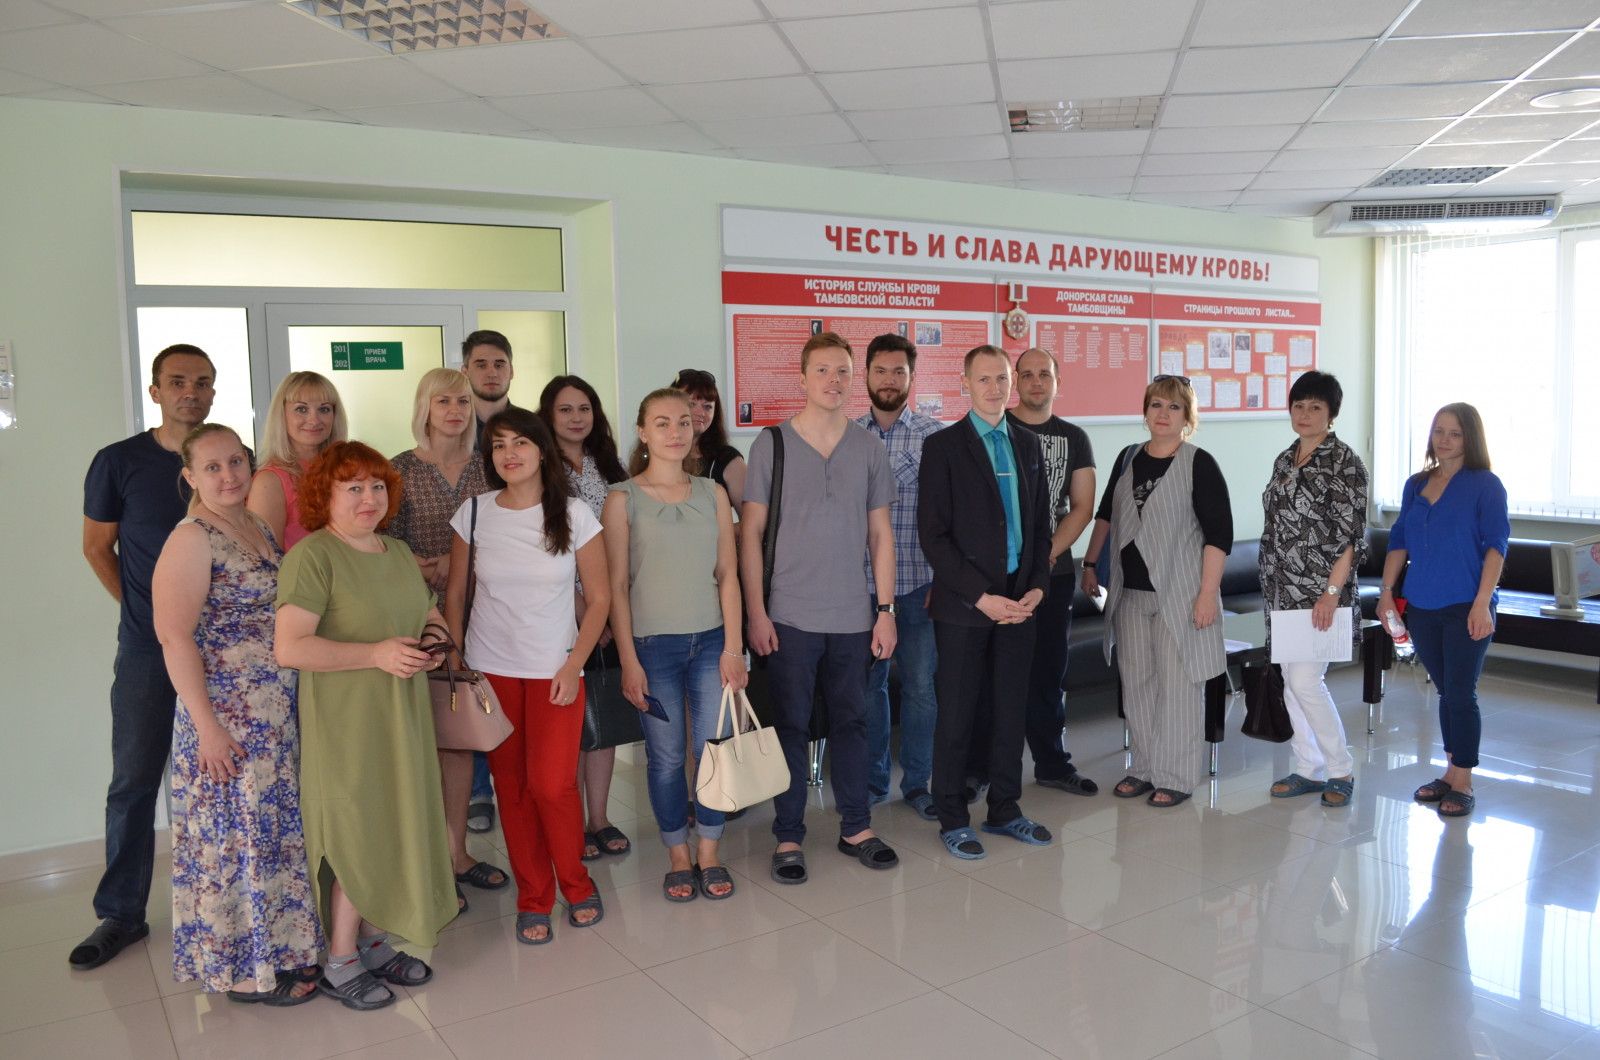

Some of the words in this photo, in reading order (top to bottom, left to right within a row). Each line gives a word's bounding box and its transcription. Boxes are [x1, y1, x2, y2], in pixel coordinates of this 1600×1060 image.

[825, 225, 918, 256] ЧЕСТЬ
[928, 233, 945, 258] И
[955, 235, 1040, 264] СЛАВА
[1049, 243, 1198, 277] ДАРУЮЩЕМУ
[1202, 257, 1270, 282] КРОВЬ!
[804, 279, 855, 291] ИСТОРИЯ
[857, 281, 904, 293] СЛУЖБЫ
[907, 283, 940, 295] КРОВИ
[814, 292, 886, 305] ТАМБОВСКОЙ
[889, 296, 935, 307] ОБЛАСТИ
[1056, 290, 1106, 303] ДОНОРСКАЯ
[1108, 294, 1134, 304] СЛАВА
[1067, 303, 1126, 316] ТАМБОВЩИНЫ
[1184, 303, 1223, 316] СТРАНИЦЫ
[1224, 305, 1261, 317] ПРОШЛОГО
[333, 345, 346, 353] 201
